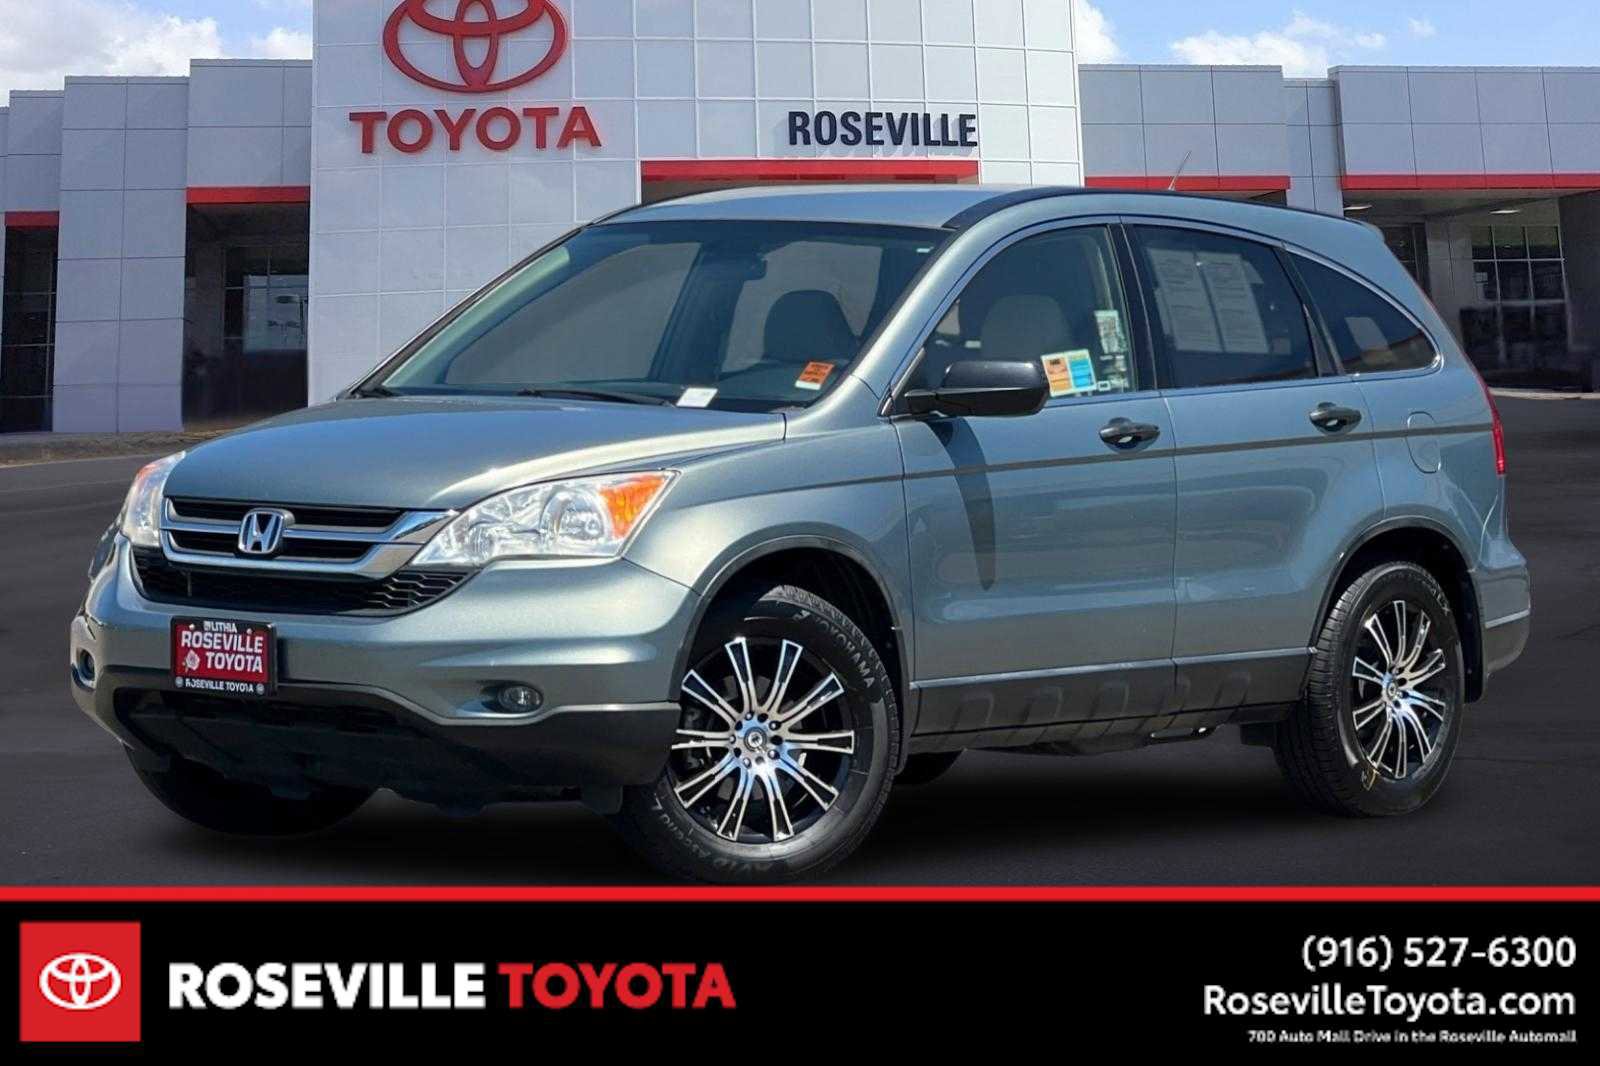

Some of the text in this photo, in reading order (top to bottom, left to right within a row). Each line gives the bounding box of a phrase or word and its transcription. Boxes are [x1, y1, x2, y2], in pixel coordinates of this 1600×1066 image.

[350, 106, 602, 154] TOYOTA
[788, 110, 979, 147] ROSEVILLE
[211, 621, 237, 633] LITHIA
[181, 630, 263, 653] ROSEVILLE
[205, 652, 262, 673] TOYOTA
[185, 678, 254, 693] ROSEVILLE TOYOTA
